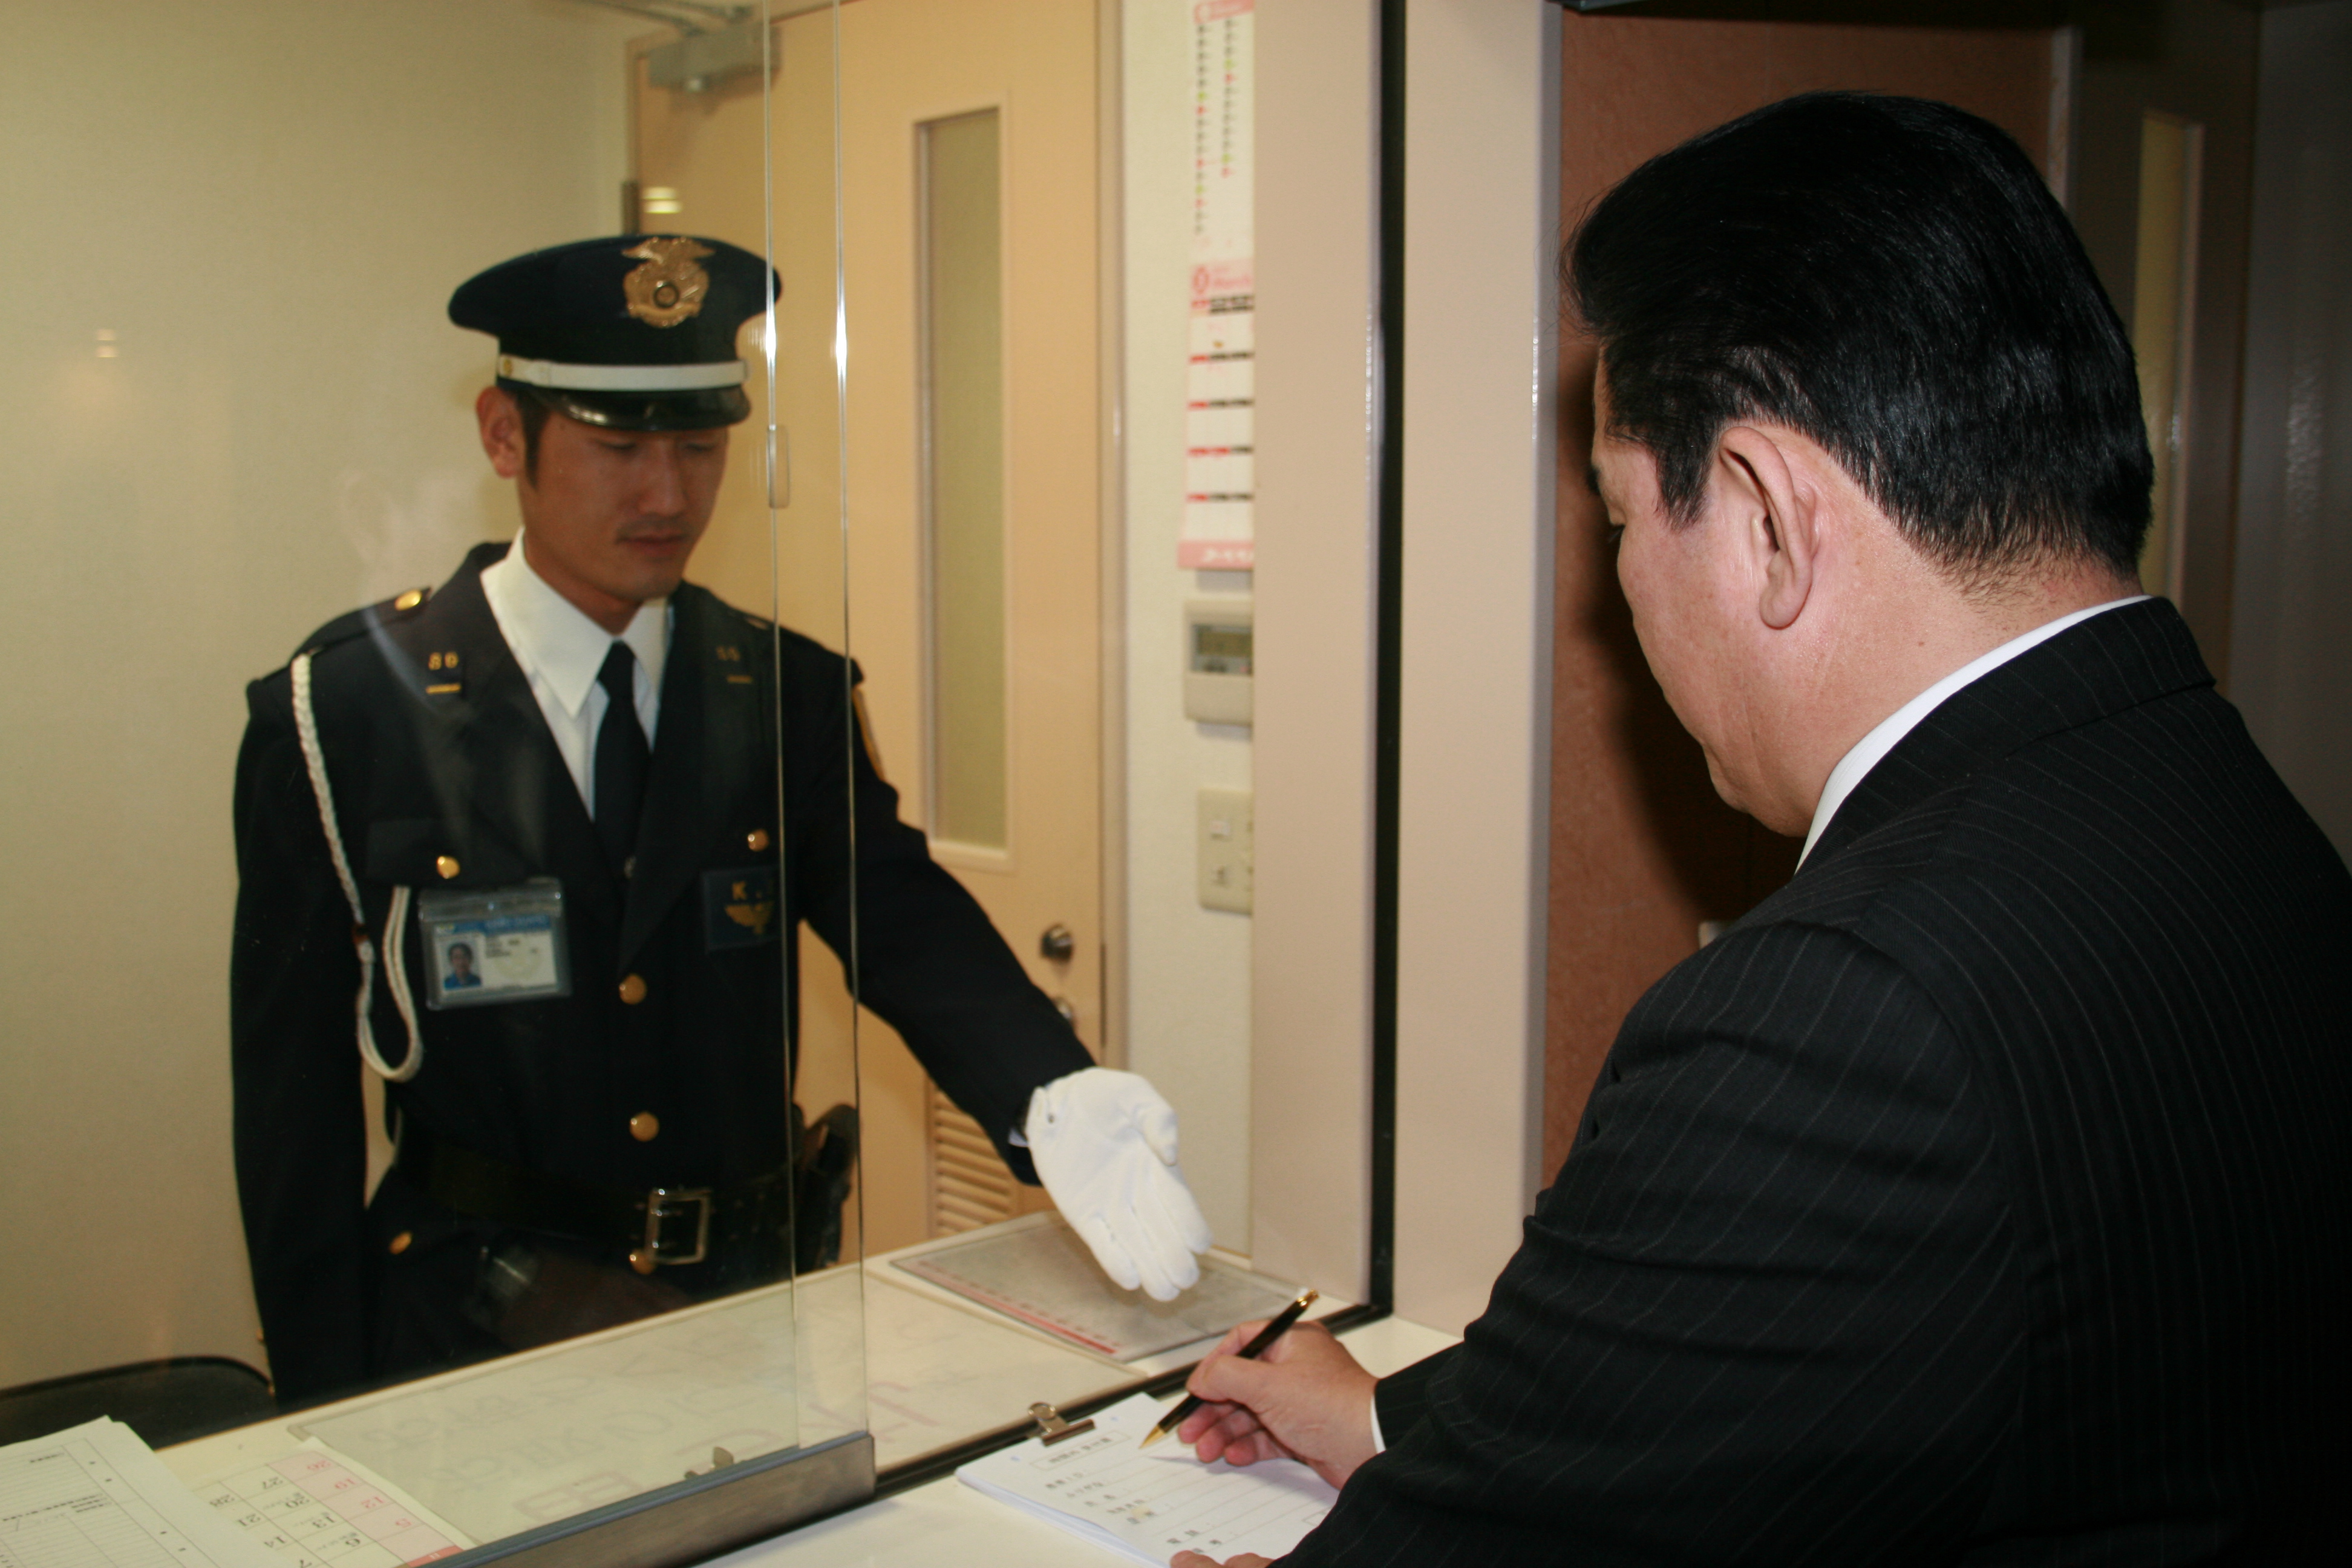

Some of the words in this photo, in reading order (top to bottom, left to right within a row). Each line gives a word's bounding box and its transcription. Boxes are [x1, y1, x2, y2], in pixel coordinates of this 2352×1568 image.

[262, 1477, 284, 1489] 27
[209, 1494, 236, 1507] 28
[286, 1496, 310, 1509] 20
[361, 1496, 385, 1509] 12
[238, 1513, 261, 1526] 21
[312, 1515, 335, 1528] 13
[395, 1517, 412, 1528] 5
[264, 1536, 285, 1548] 14
[345, 1538, 361, 1547] 6
